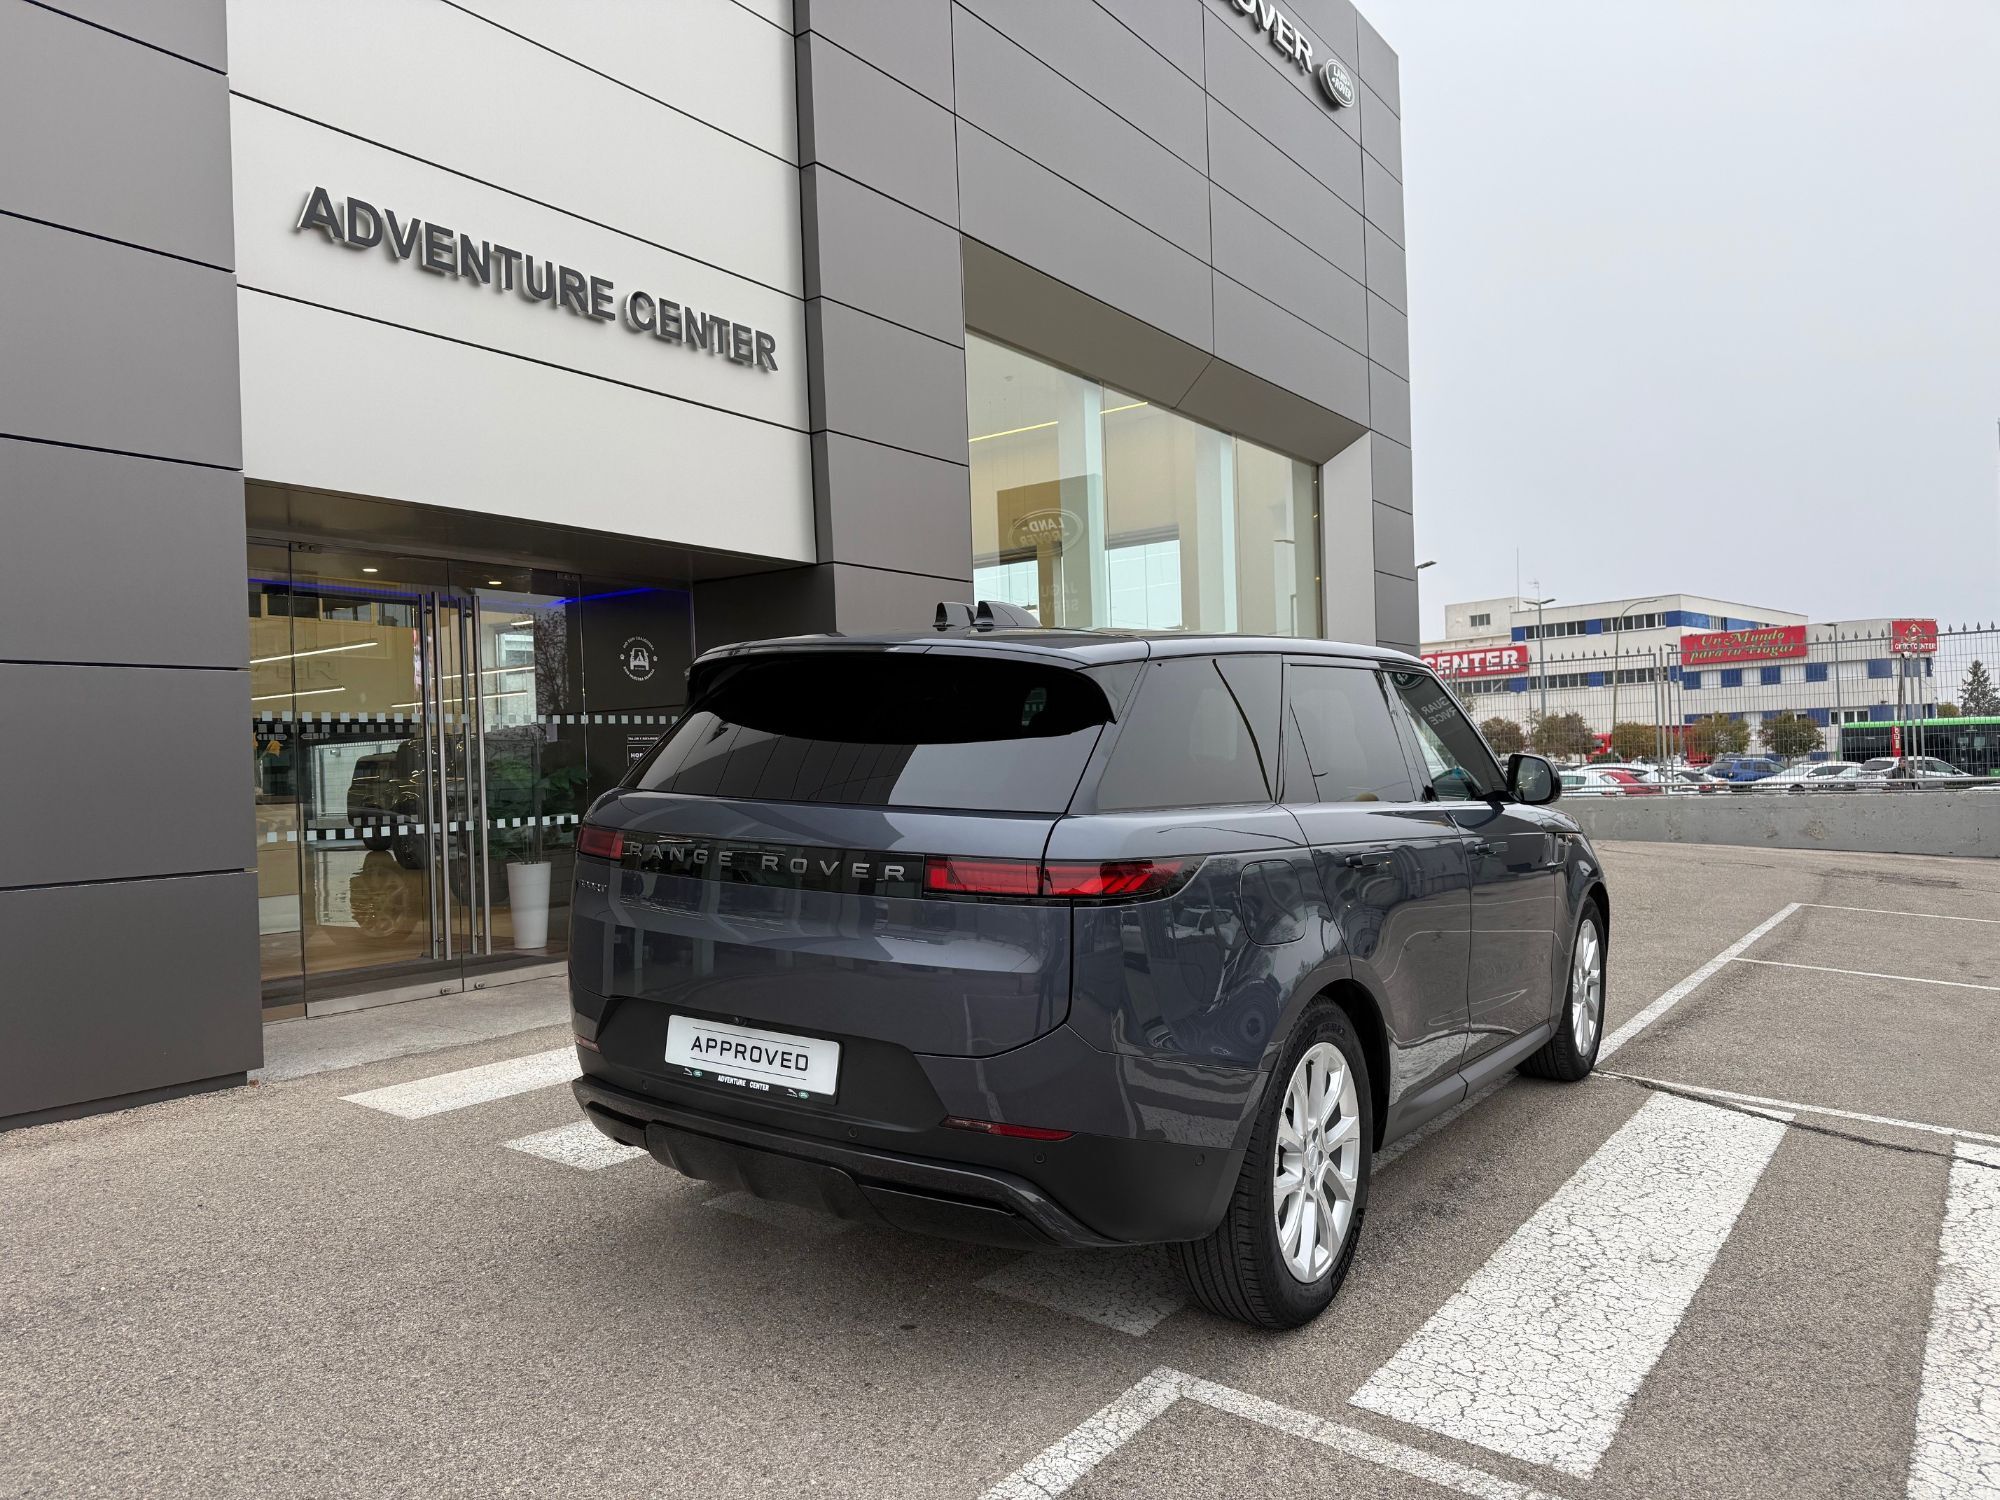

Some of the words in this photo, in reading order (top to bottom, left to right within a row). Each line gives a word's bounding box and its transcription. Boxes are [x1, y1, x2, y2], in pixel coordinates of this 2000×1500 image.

[1333, 65, 1350, 86] LAND
[1333, 79, 1352, 101] ROVER
[297, 186, 616, 322] ADVENTURE
[626, 290, 779, 372] CENTER
[1701, 635, 1721, 646] Un
[1724, 629, 1785, 646] Mundo
[1690, 648, 1722, 663] para
[628, 842, 733, 867] RANGE
[761, 855, 905, 882] ROVER
[690, 1035, 809, 1072] APPROVED
[717, 1074, 747, 1087] ADVENTURE
[749, 1081, 770, 1092] CENTER
